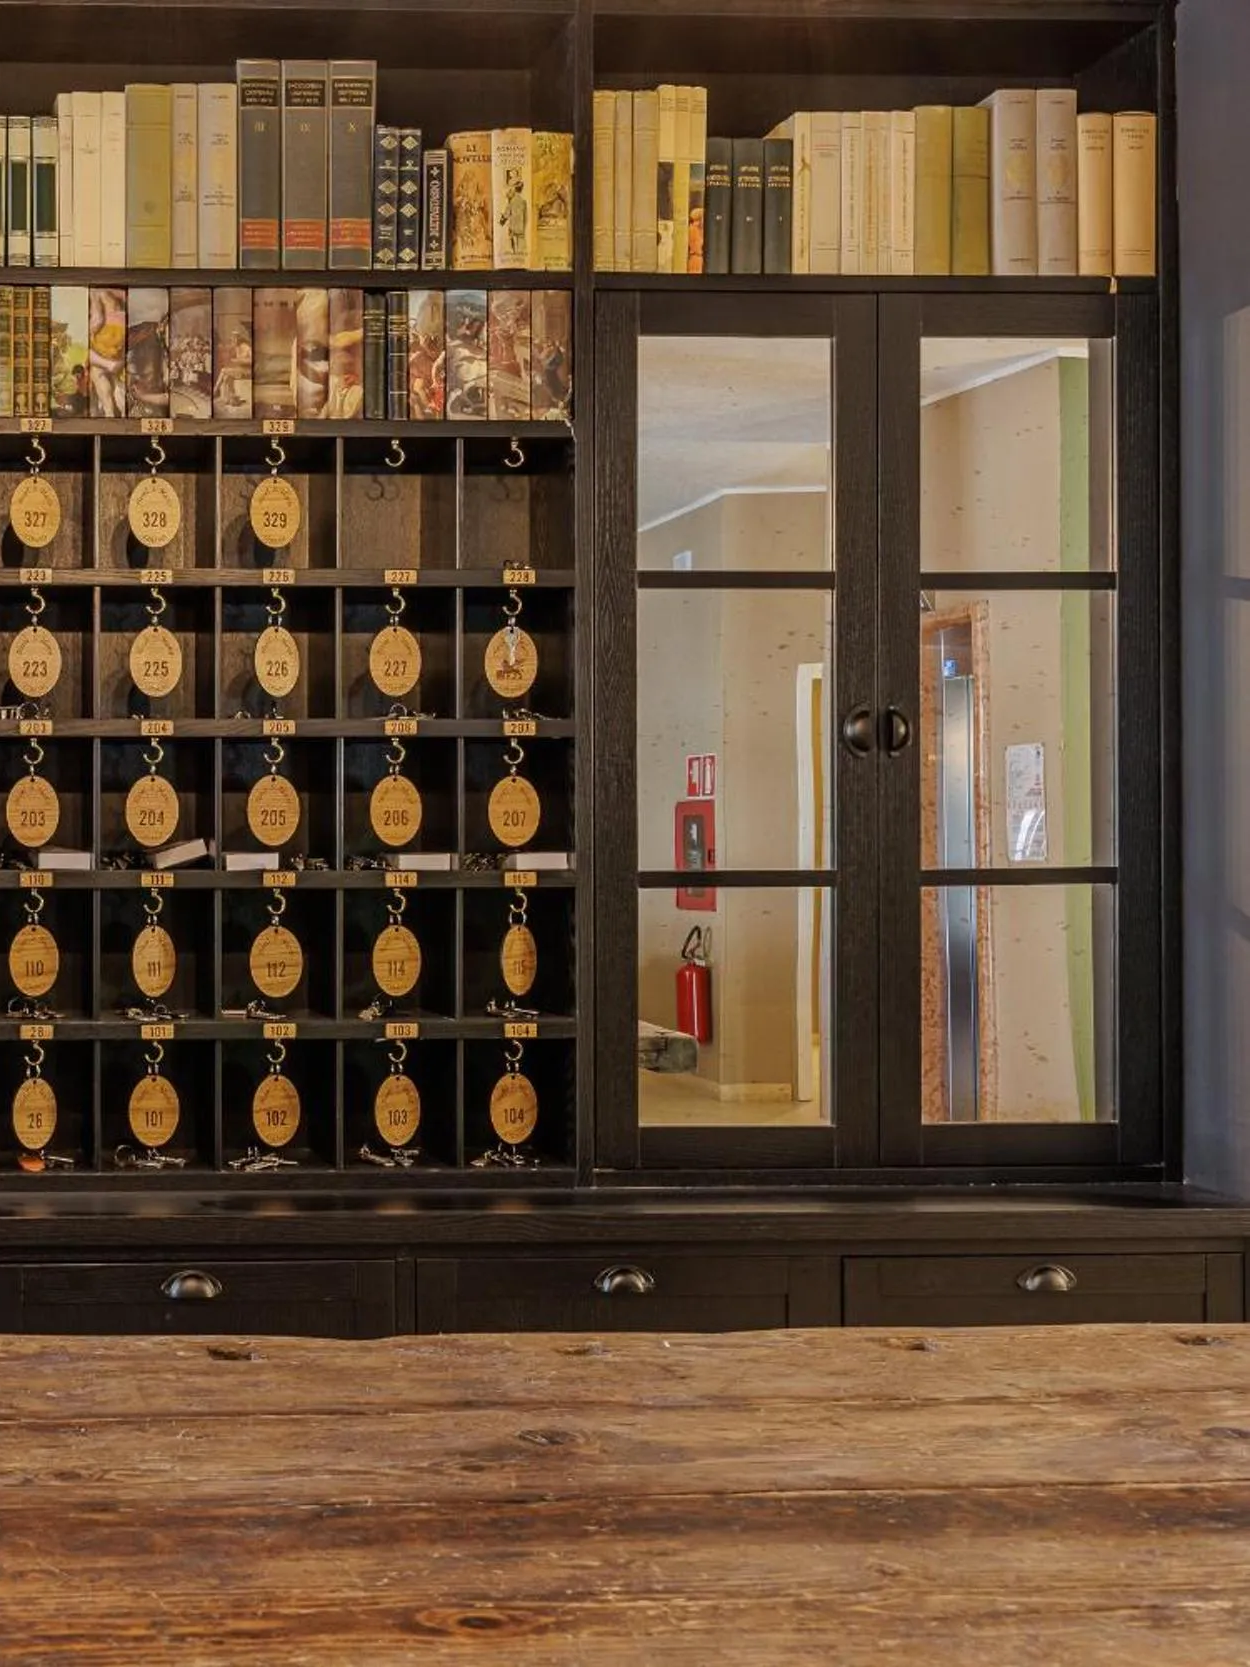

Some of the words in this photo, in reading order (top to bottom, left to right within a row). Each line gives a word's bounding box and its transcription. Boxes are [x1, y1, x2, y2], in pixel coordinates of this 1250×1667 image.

[270, 421, 289, 432] 329
[24, 512, 46, 528] 327
[142, 512, 166, 528] 328
[263, 512, 287, 529] 329
[147, 570, 166, 581] 225
[269, 571, 289, 581] 226
[391, 571, 410, 582] 227
[510, 571, 529, 582] 228
[22, 661, 48, 677] 223
[144, 661, 169, 676] 225
[266, 661, 288, 676] 226
[384, 660, 407, 676] 227
[20, 811, 46, 826] 203
[139, 810, 164, 826] 204
[261, 809, 286, 826] 205
[384, 809, 409, 826] 206
[503, 811, 525, 827] 207
[151, 874, 164, 884] 111
[271, 874, 288, 885] 112
[394, 874, 409, 885] 114
[26, 960, 44, 977] 110
[147, 960, 161, 977] 111
[267, 962, 286, 978] 112
[388, 960, 406, 977] 114
[150, 1027, 166, 1038] 101
[270, 1025, 289, 1036] 102
[393, 1025, 411, 1036] 103
[510, 1025, 529, 1036] 104
[28, 1112, 42, 1129] 26
[145, 1111, 163, 1128] 101
[266, 1110, 287, 1126] 102
[389, 1110, 408, 1126] 103
[504, 1108, 524, 1124] 104
